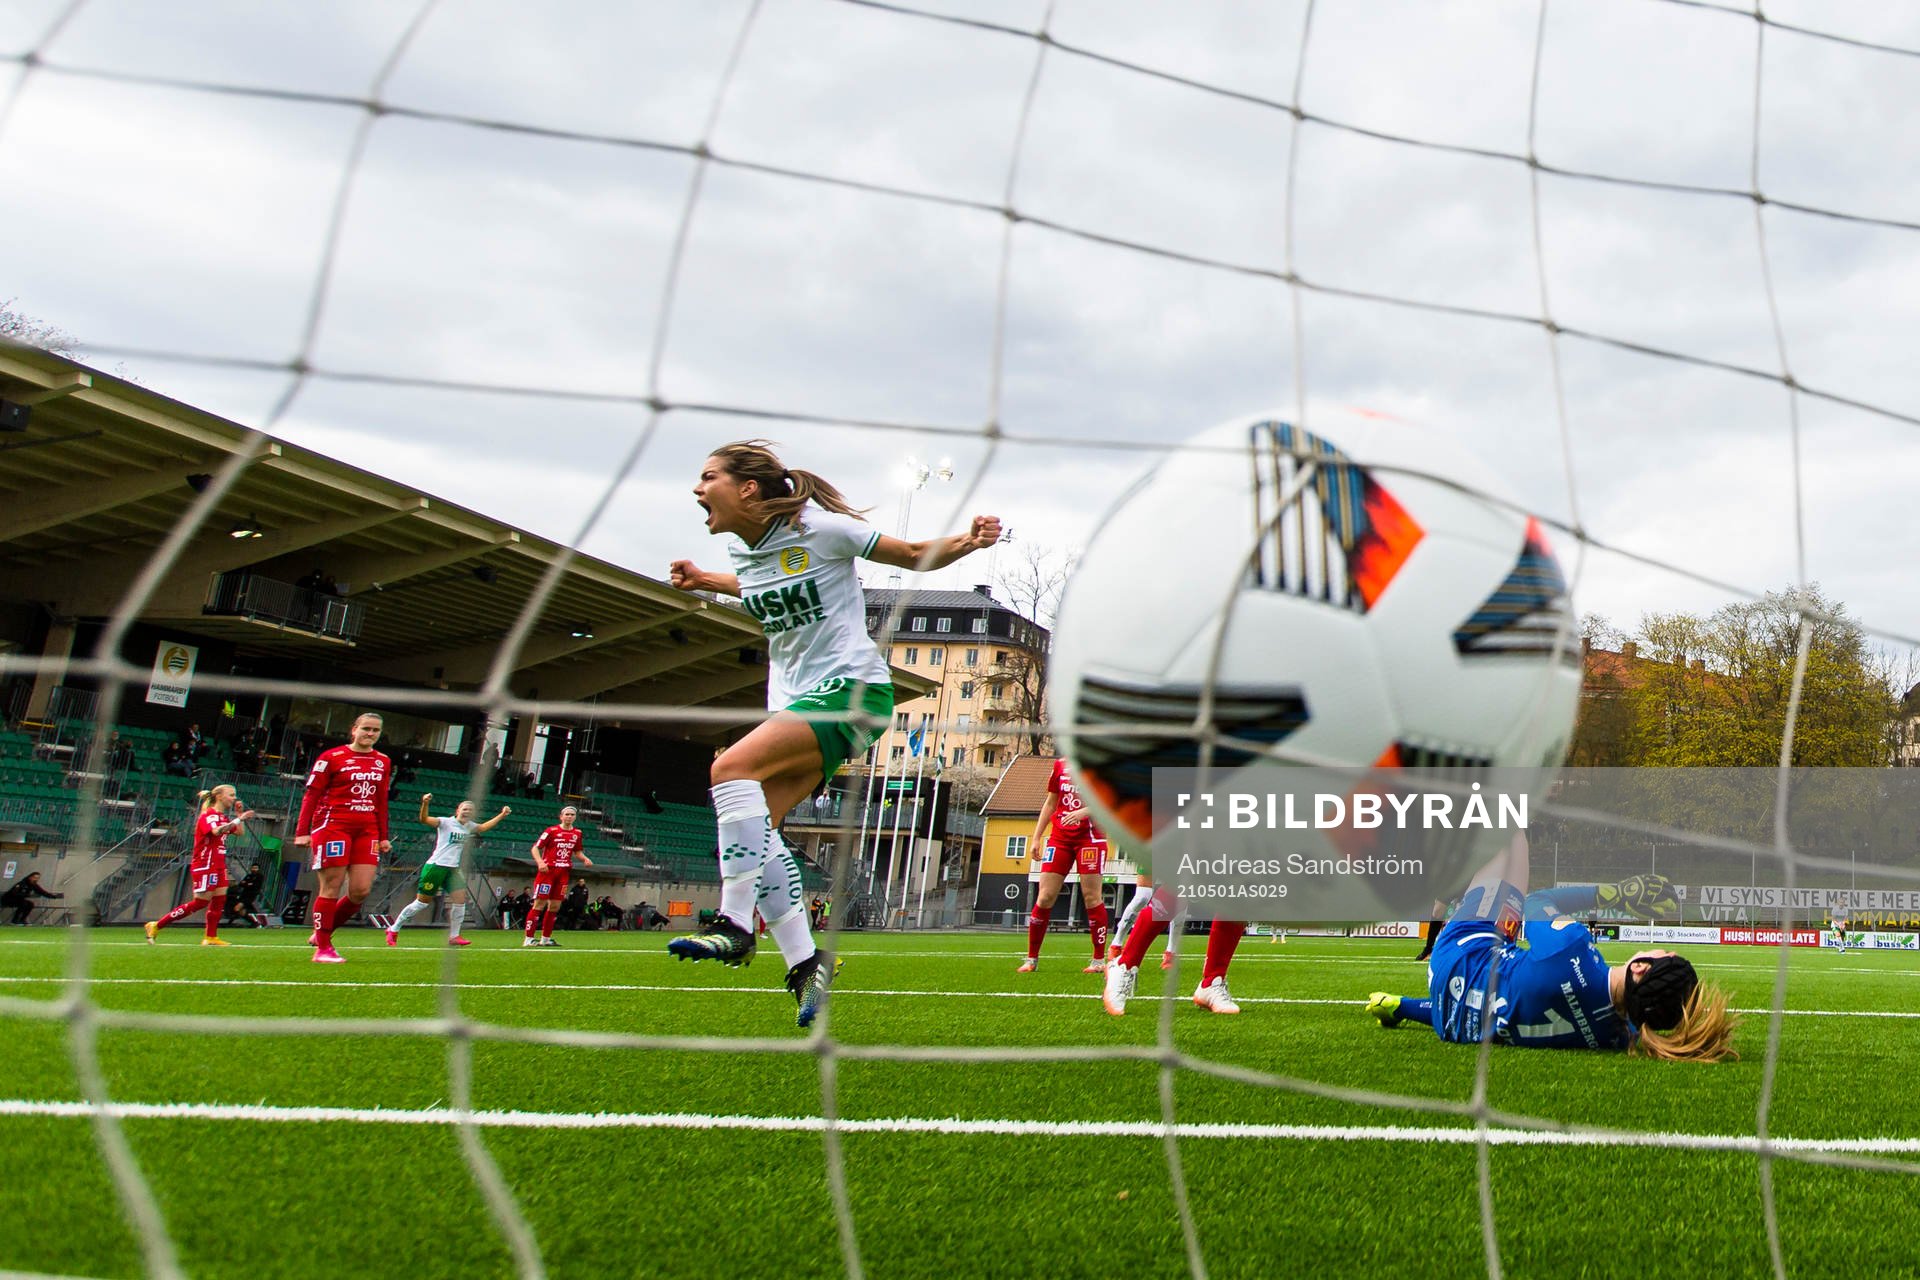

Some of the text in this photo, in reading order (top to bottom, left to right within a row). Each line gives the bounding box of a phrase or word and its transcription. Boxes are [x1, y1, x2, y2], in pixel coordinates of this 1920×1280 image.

[743, 579, 821, 621] USKI
[351, 772, 382, 781] renta
[1705, 887, 1724, 903] VI
[1730, 888, 1775, 905] SYNS
[1781, 889, 1820, 907] INTE
[1826, 891, 1860, 907] MEN
[1700, 905, 1748, 922] VITA
[1756, 932, 1816, 944] CHOCOLATE
[1516, 1007, 1575, 1038] 1
